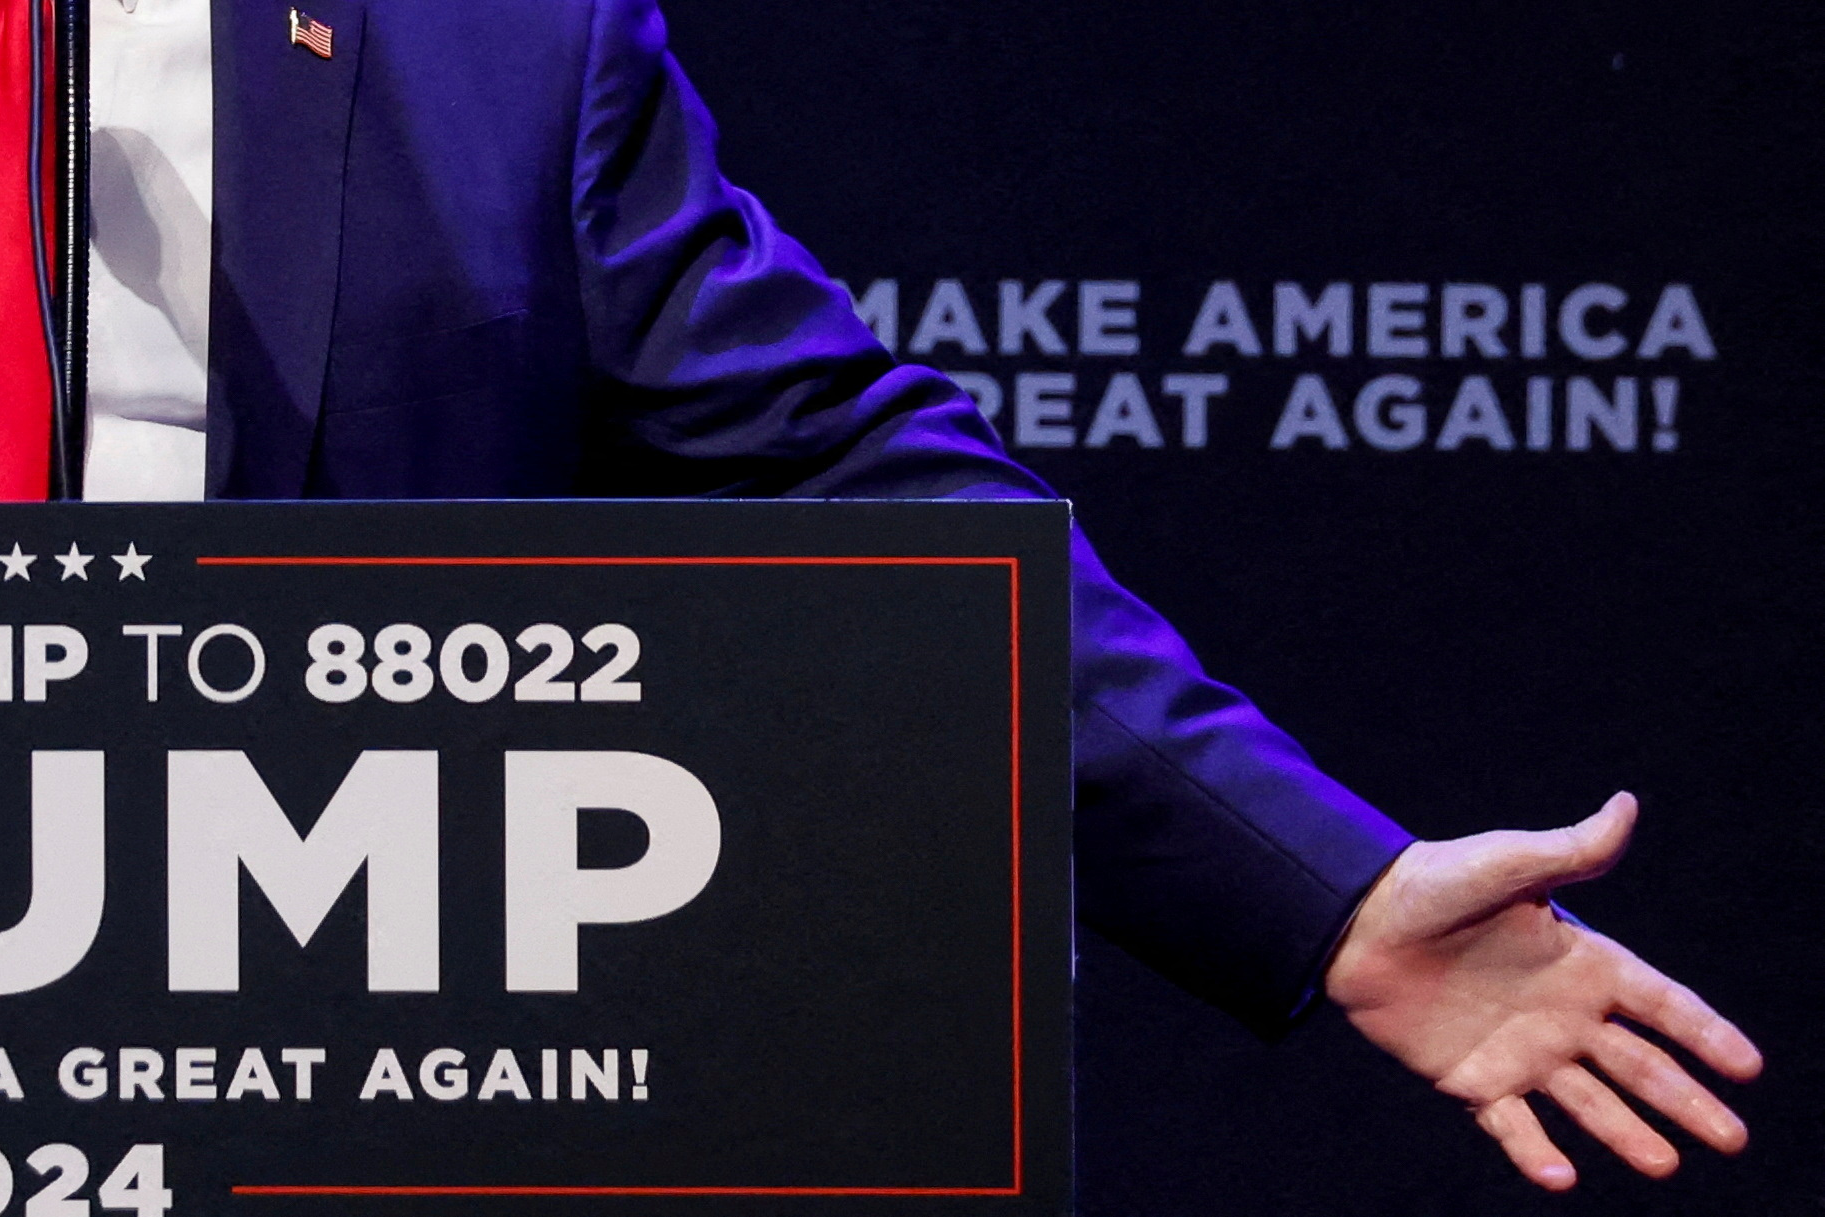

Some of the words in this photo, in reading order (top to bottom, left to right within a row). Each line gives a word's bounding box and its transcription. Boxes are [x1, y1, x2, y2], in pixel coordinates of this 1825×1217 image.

[1182, 280, 1718, 360] AMERICA
[1269, 373, 1680, 453] AGAIN!
[122, 623, 266, 704] TO
[304, 622, 642, 704] 88022
[57, 1046, 326, 1101] GREAT
[358, 1047, 649, 1101] AGAIN!
